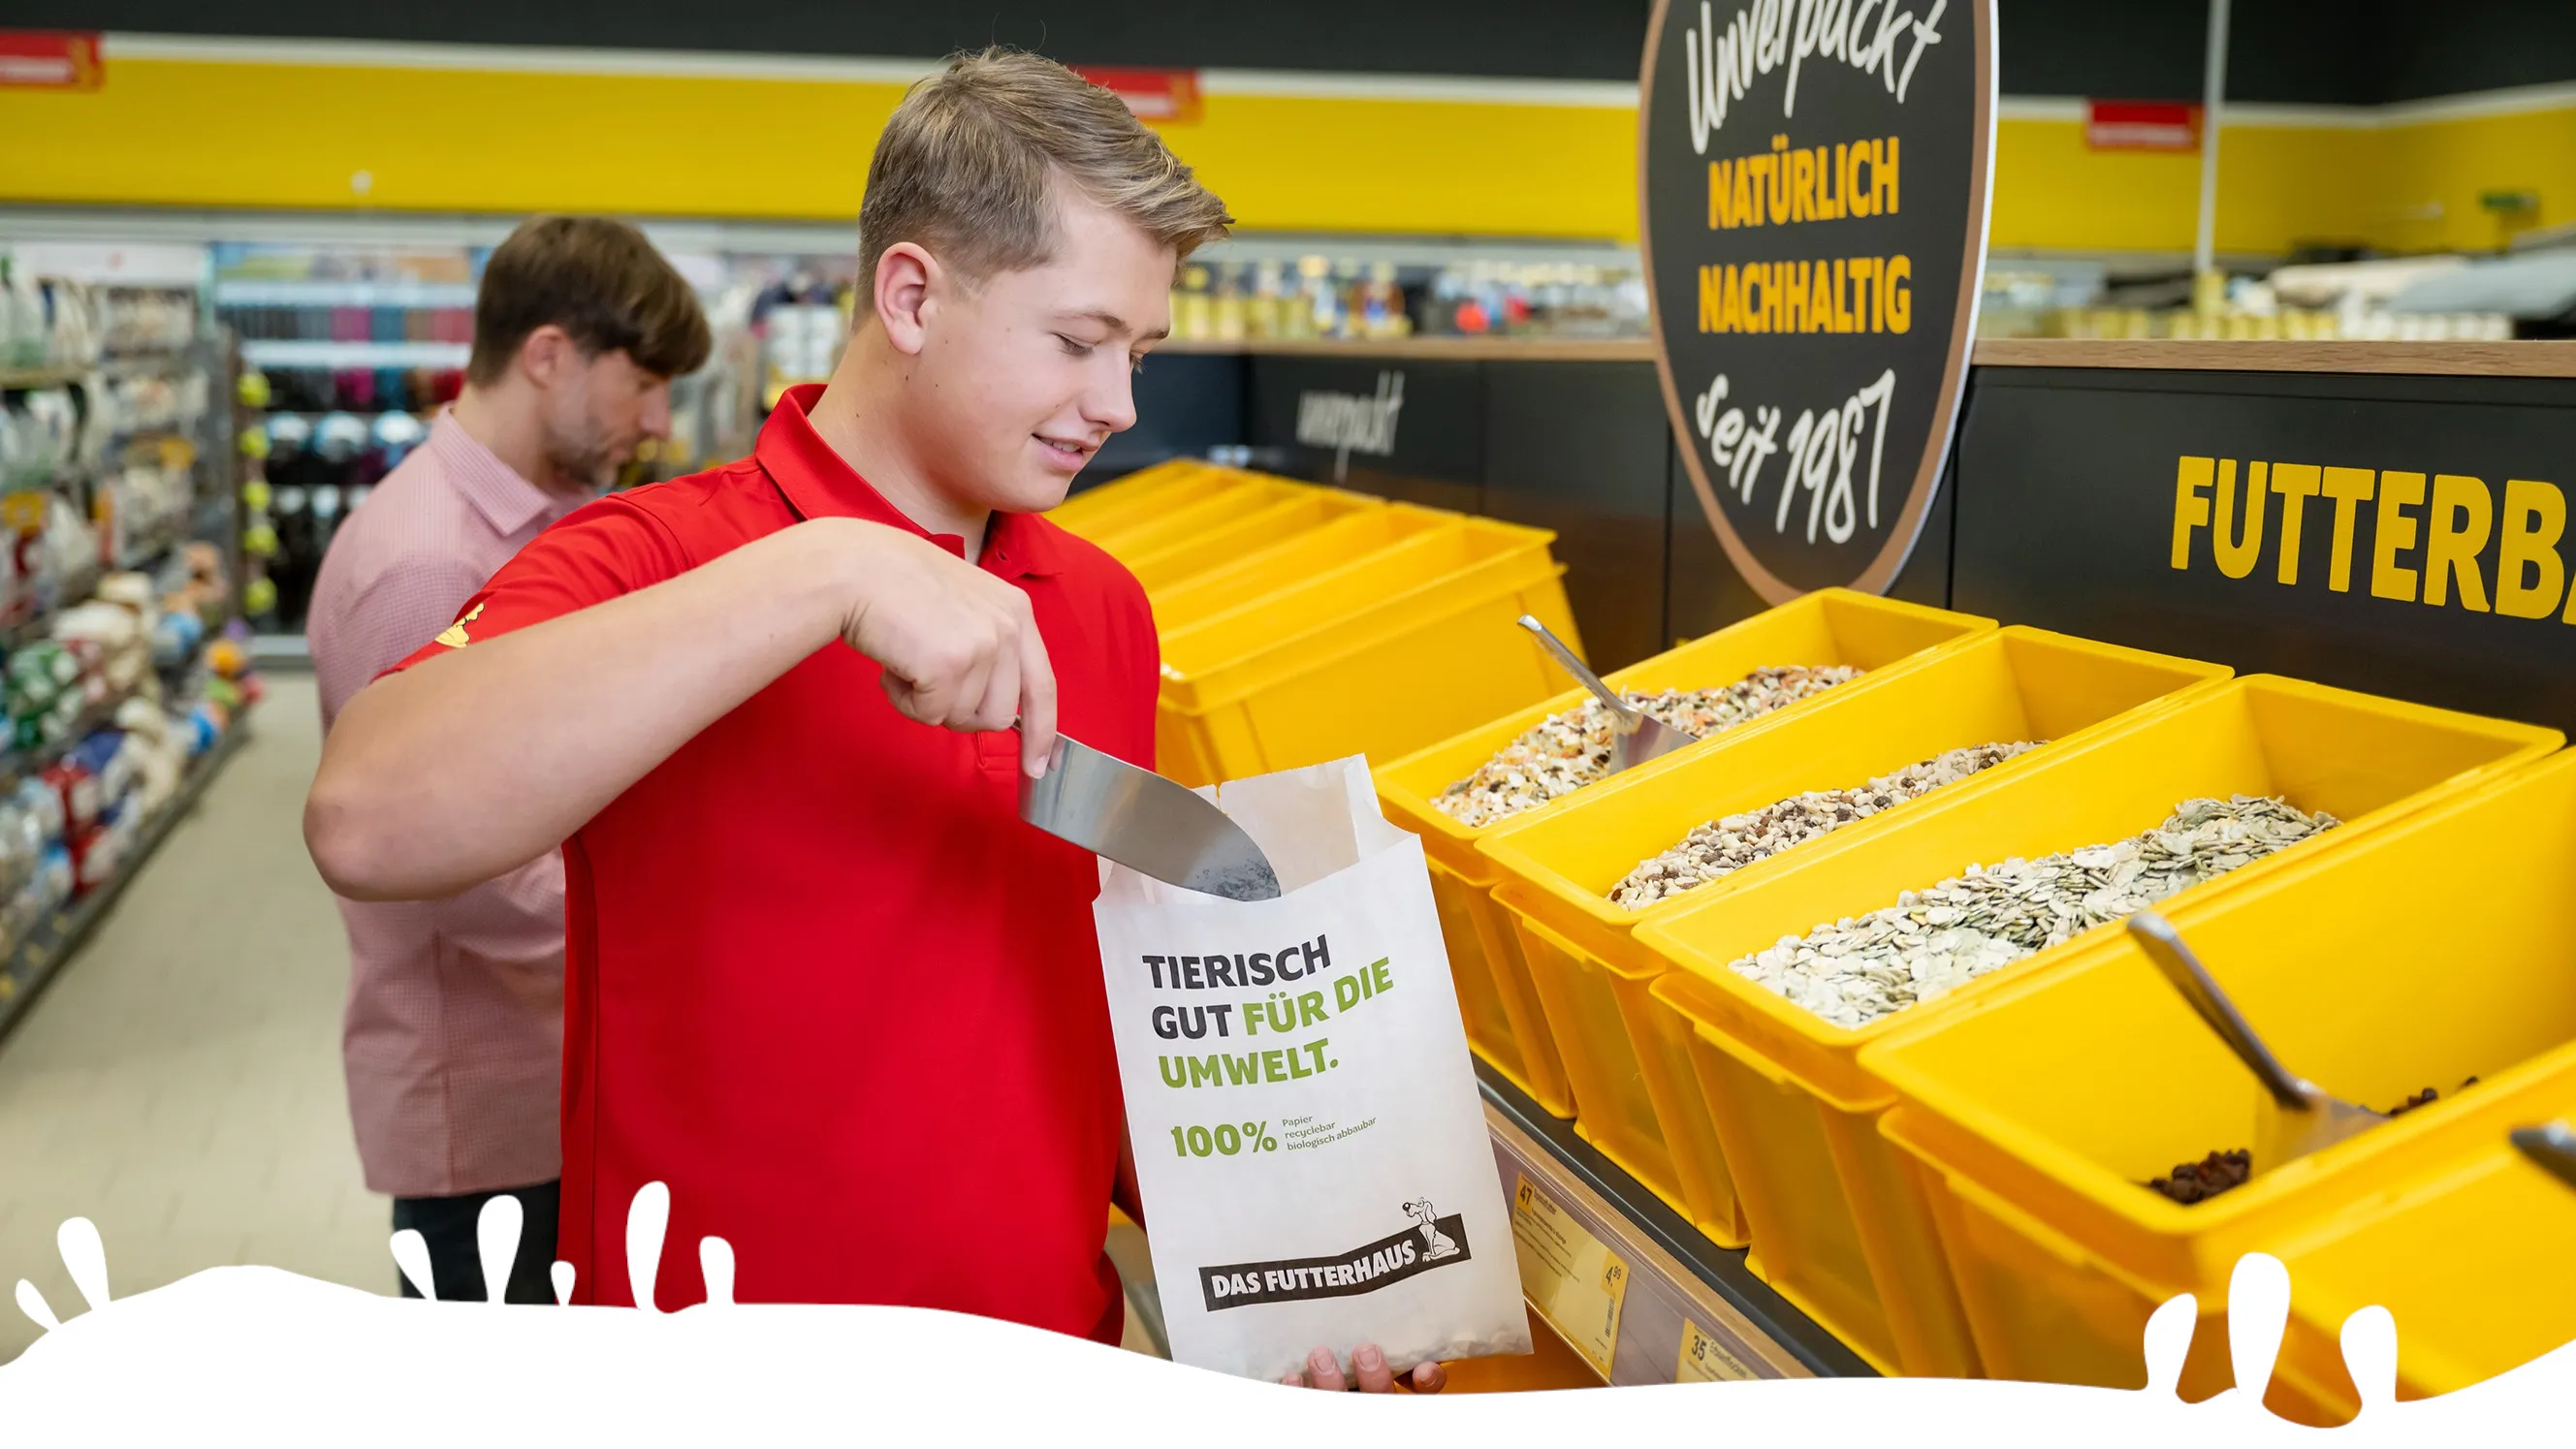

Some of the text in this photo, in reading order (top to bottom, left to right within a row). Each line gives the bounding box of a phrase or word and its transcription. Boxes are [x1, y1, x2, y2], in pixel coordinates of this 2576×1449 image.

[1708, 133, 1899, 230] NATÜRLICH
[1699, 254, 1911, 333] NACHHALTIG
[1697, 367, 1895, 544] seit 1987
[2171, 456, 2576, 625] FUTTERB
[1142, 933, 1331, 990] TIERISCH
[1152, 957, 1393, 1040] GUT FÜR DIE
[1158, 1037, 1339, 1088] UMWELT.
[1170, 1120, 1278, 1158] 100%
[1282, 1115, 1314, 1128] Papier
[1285, 1121, 1336, 1140] recyclebar
[1287, 1117, 1377, 1151] biologisch abbaubar
[1519, 1183, 1532, 1205] 47
[1211, 1239, 1416, 1299] DAS FUTTERHAUS
[1691, 1335, 1706, 1361] 35
